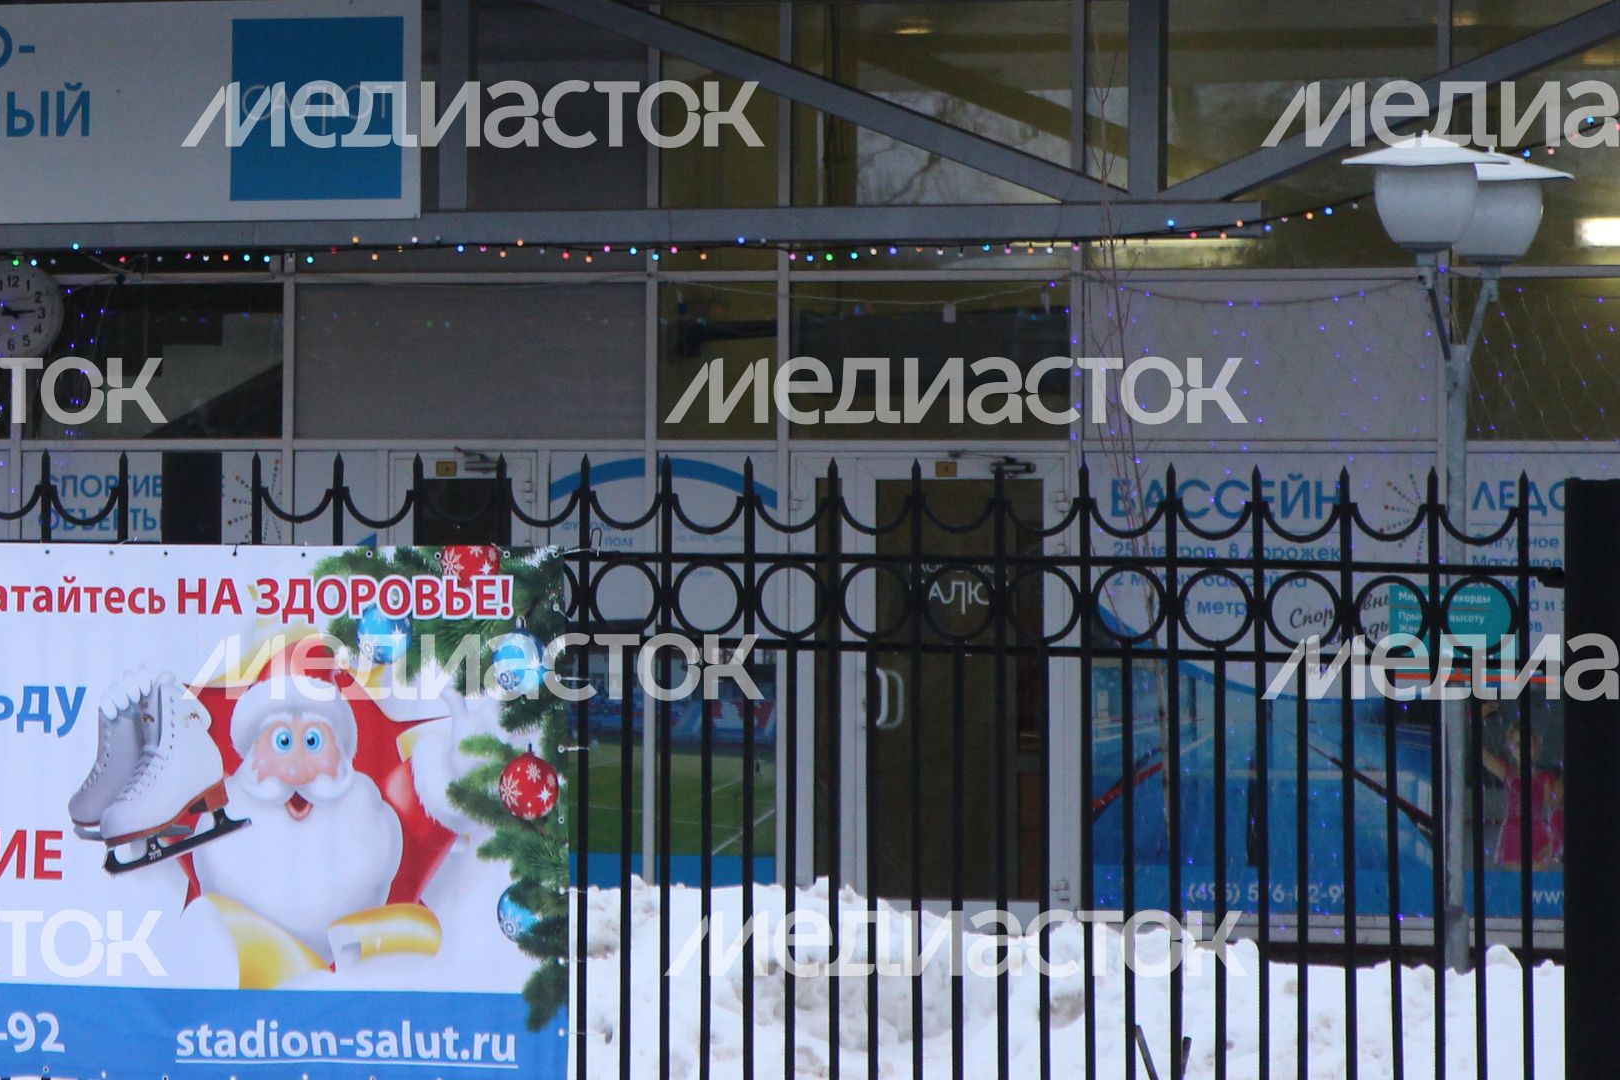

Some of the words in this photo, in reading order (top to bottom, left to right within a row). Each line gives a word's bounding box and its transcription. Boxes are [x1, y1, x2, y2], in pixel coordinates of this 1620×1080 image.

[7, 275, 20, 288] 12
[178, 578, 243, 616] НА
[254, 576, 513, 625] ЗДОРОВЬЕ!
[175, 1018, 517, 1064] stadion-salut.ru
